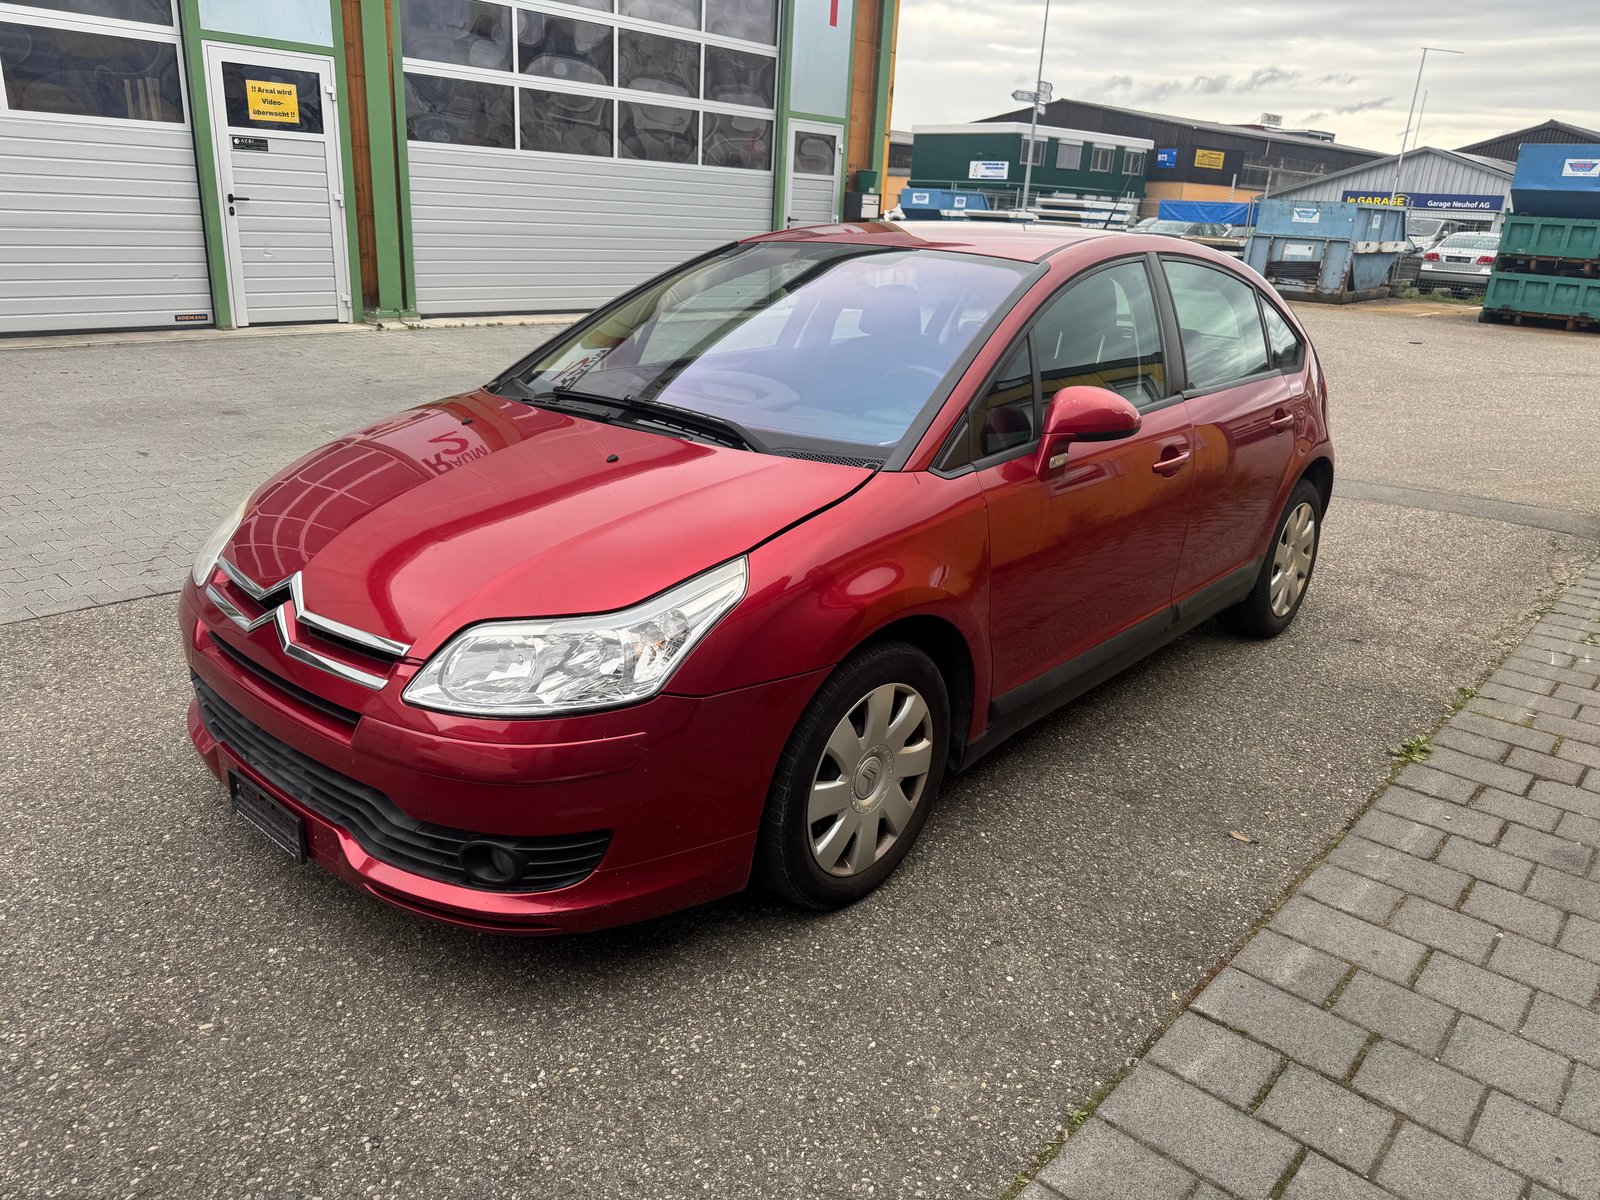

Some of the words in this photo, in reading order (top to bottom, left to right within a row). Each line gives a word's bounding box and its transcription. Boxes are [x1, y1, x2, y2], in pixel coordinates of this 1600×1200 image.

[257, 86, 276, 94] Areal
[277, 88, 292, 96] wird
[261, 98, 284, 106] Video-
[252, 109, 290, 118] überwacht
[1347, 196, 1356, 204] le
[1357, 196, 1405, 206] GARAGE
[1427, 199, 1452, 209] Garage
[1452, 200, 1478, 208] Neuhof
[1478, 201, 1491, 209] AG
